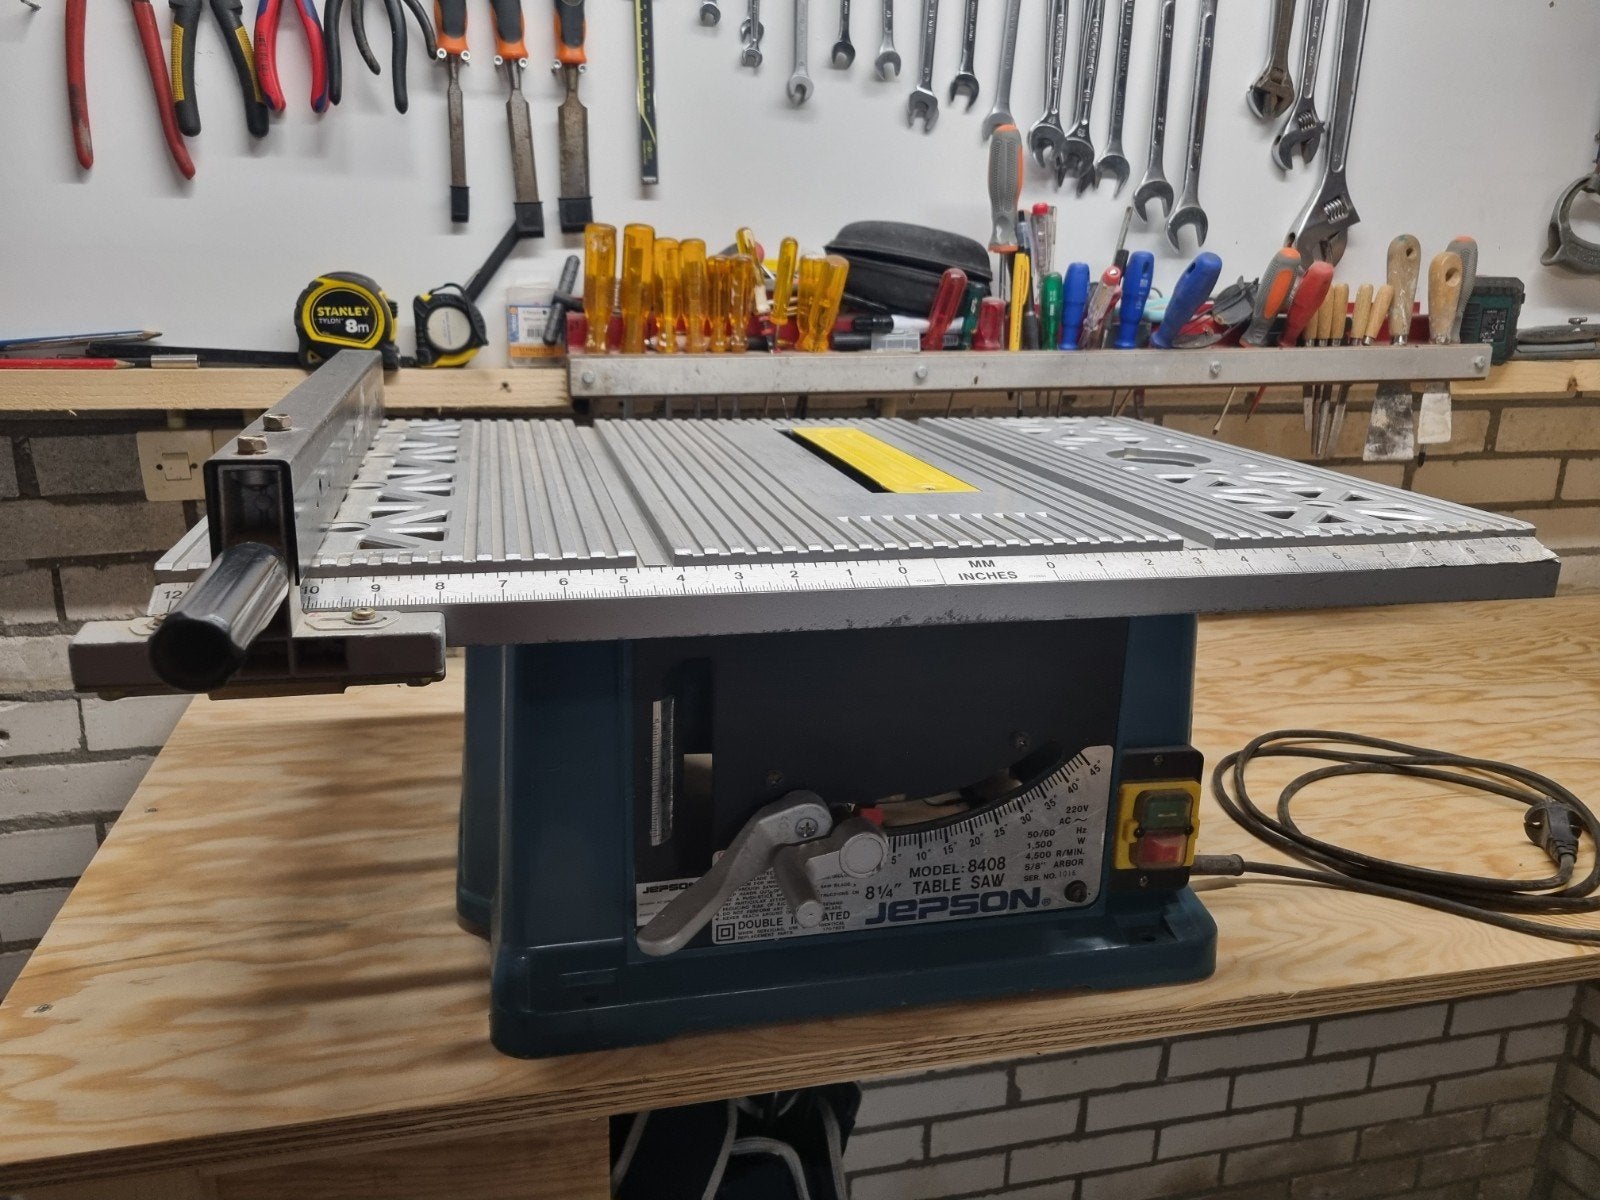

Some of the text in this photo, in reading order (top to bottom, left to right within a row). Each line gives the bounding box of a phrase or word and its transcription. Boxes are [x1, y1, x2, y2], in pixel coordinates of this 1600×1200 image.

[317, 306, 370, 317] STANLEY
[345, 319, 370, 334] 8m
[1046, 561, 1056, 569] 0
[1506, 544, 1522, 552] 10
[968, 560, 996, 568] MM
[958, 570, 1018, 581] INCHES
[163, 590, 182, 599] 12
[371, 584, 381, 592] 9
[435, 582, 445, 590] 8
[499, 580, 508, 588] 7
[559, 578, 568, 586] 6
[619, 576, 628, 584] 5
[676, 574, 686, 582] 4
[734, 572, 744, 580] 3
[790, 570, 799, 578] 2
[898, 566, 907, 574] 0
[1066, 805, 1089, 813] 220V
[1059, 817, 1071, 825] AC
[1027, 829, 1056, 838] 50/60
[1025, 848, 1085, 860] 4,500 R/MIN.
[1053, 859, 1084, 868] ARBOR
[913, 877, 961, 895] TABLE
[971, 873, 1006, 890] SAW
[738, 917, 783, 930] DOUBLE
